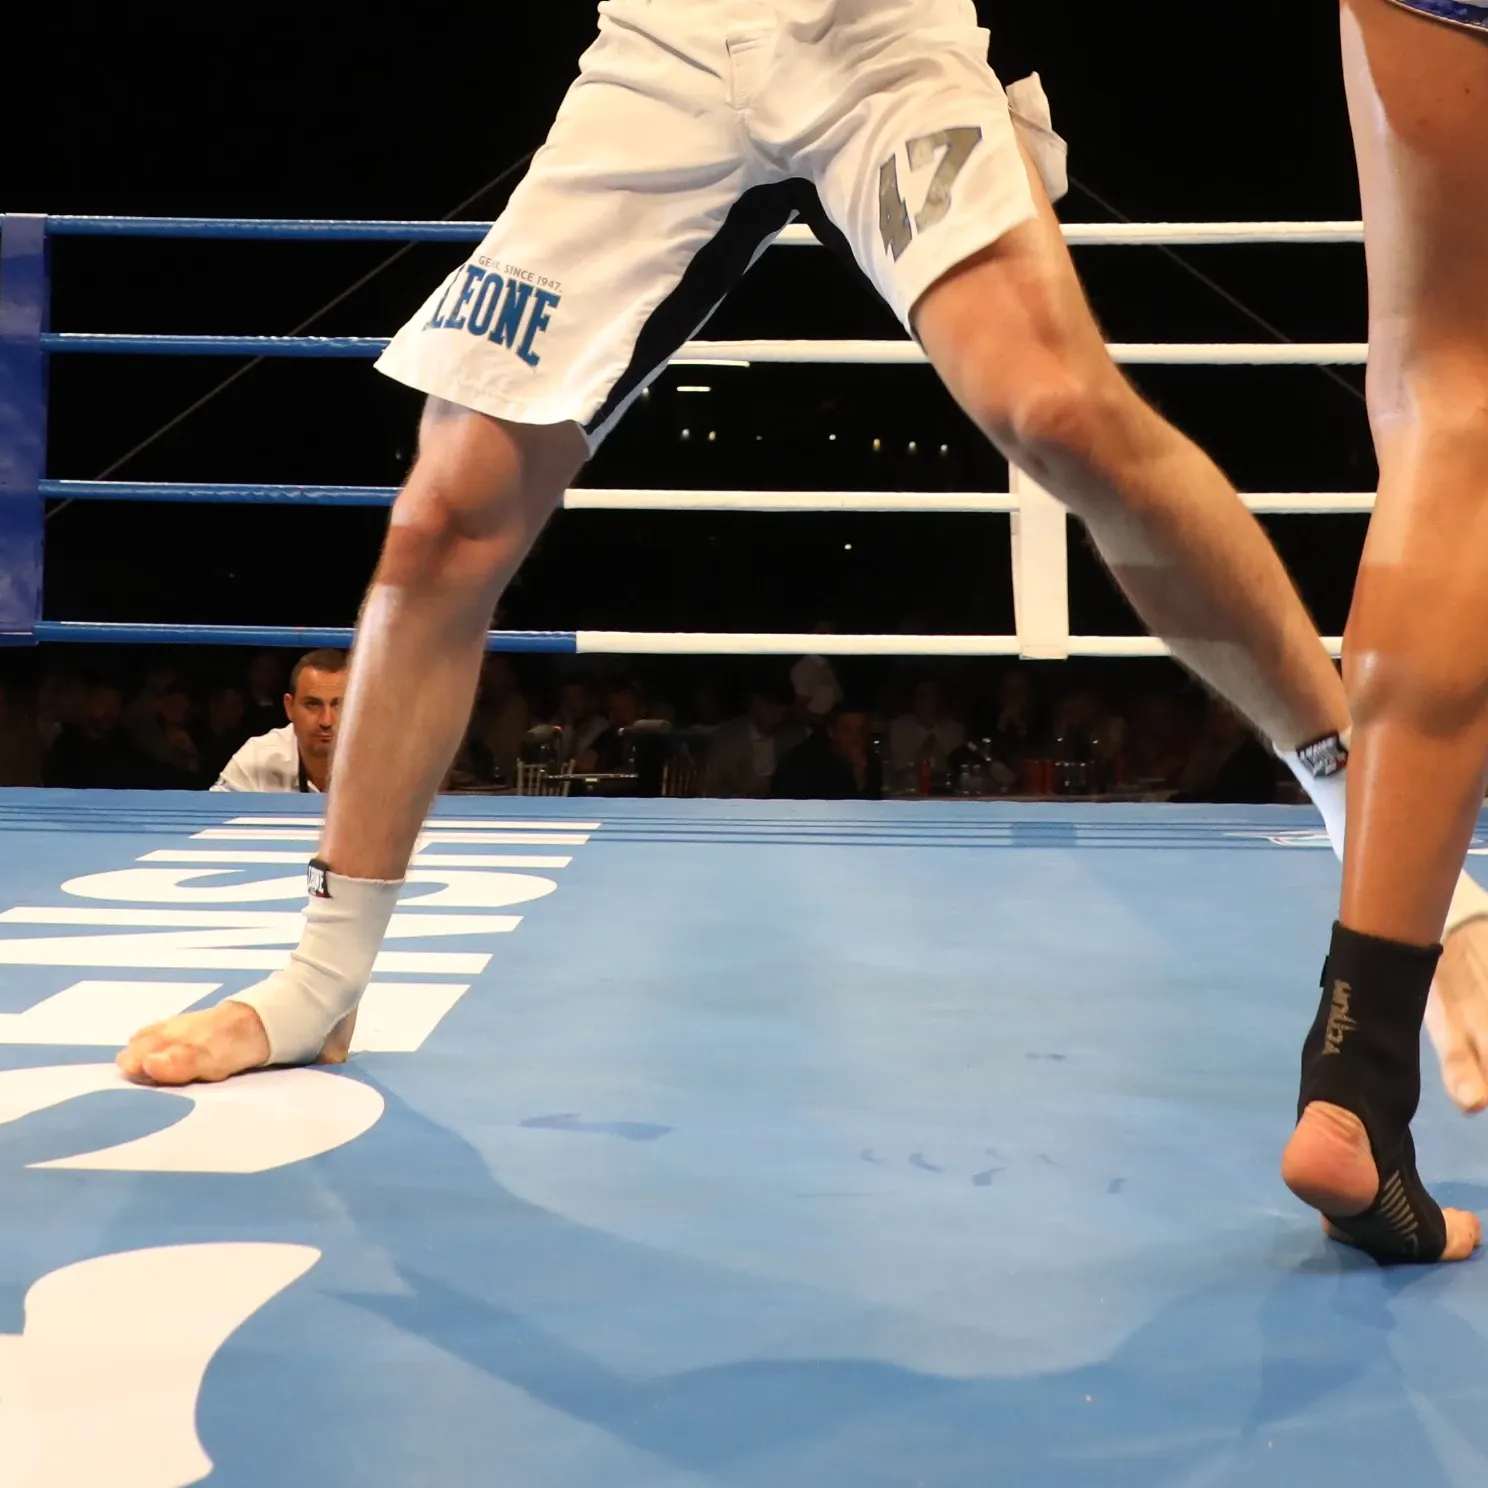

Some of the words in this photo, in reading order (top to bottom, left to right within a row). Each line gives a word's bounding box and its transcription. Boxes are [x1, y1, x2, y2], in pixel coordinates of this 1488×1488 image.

[478, 255, 501, 271] GE
[503, 264, 535, 283] SINCE
[421, 263, 561, 369] LEONE
